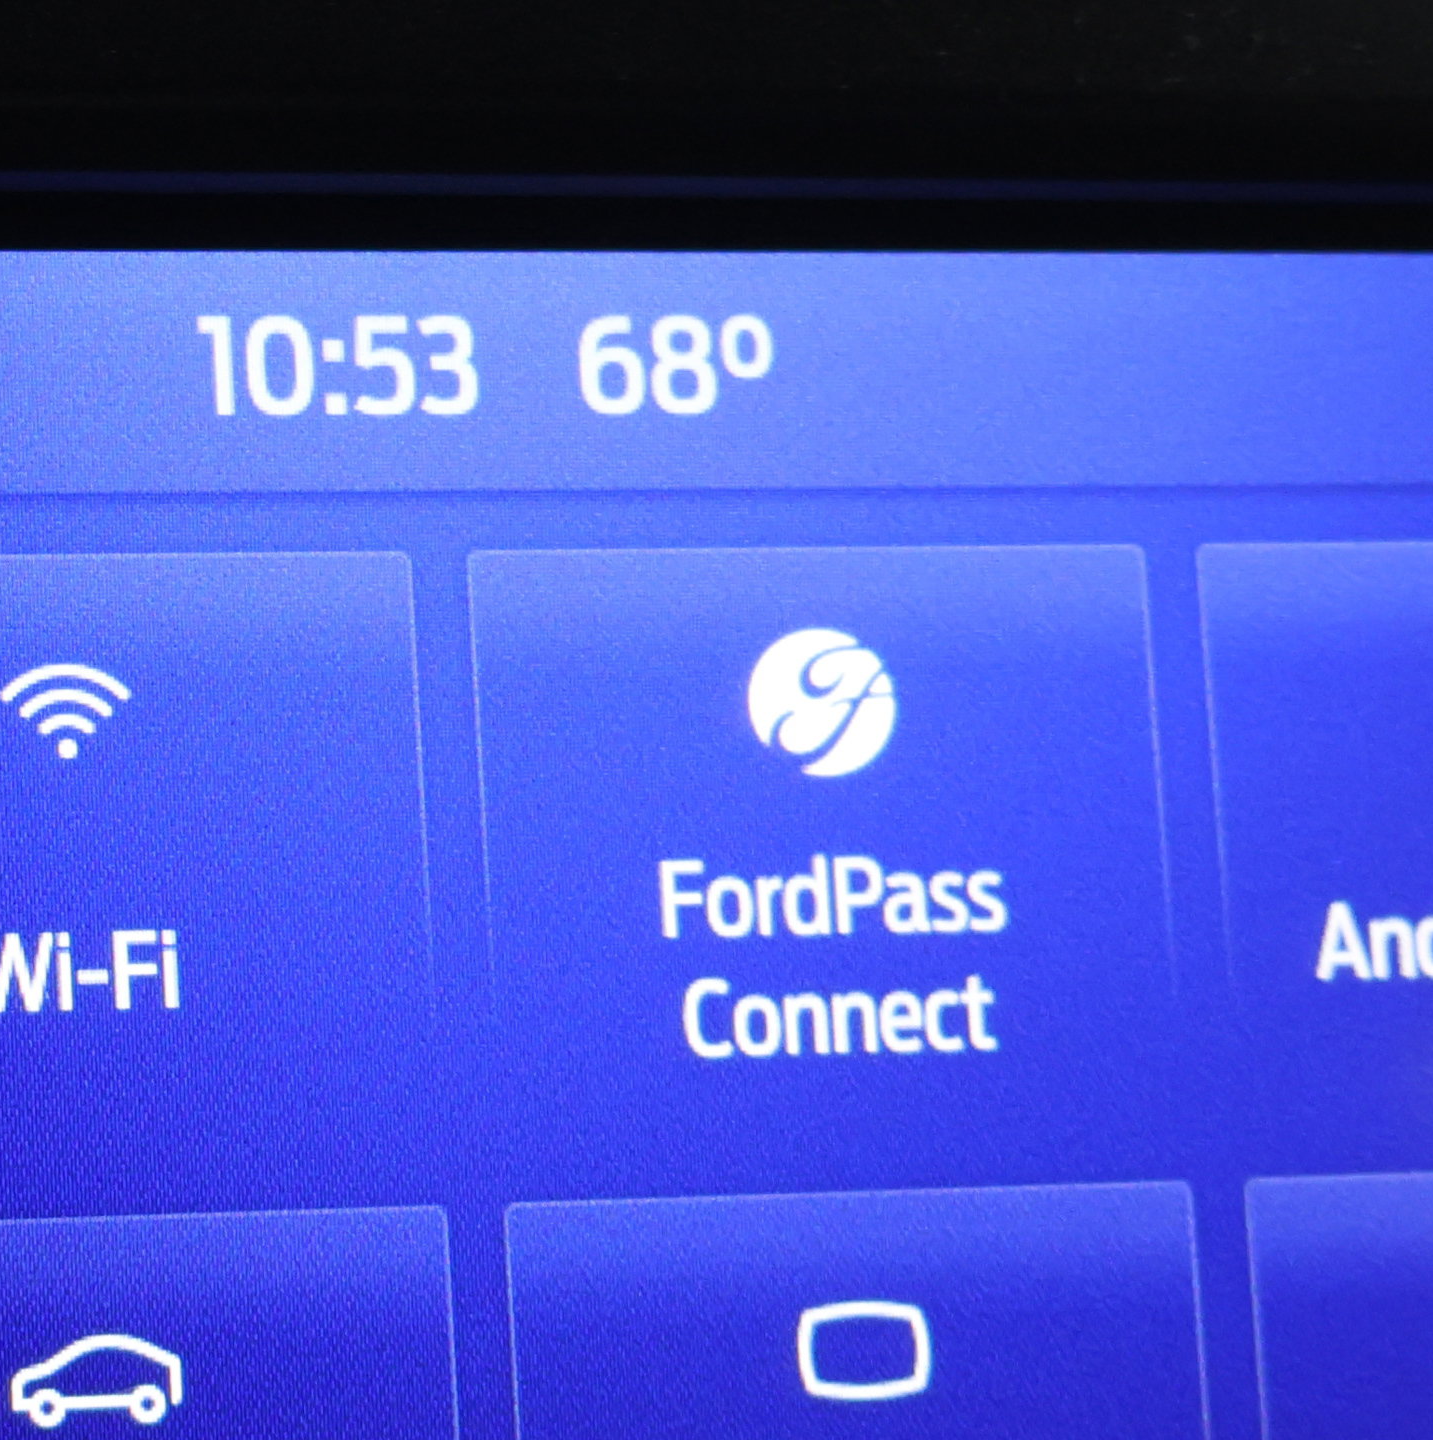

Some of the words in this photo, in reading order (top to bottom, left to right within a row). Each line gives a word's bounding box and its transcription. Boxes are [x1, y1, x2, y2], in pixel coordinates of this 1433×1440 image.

[195, 313, 479, 418] 10:53
[657, 853, 1008, 940] FordPass
[681, 974, 997, 1060] Connect
